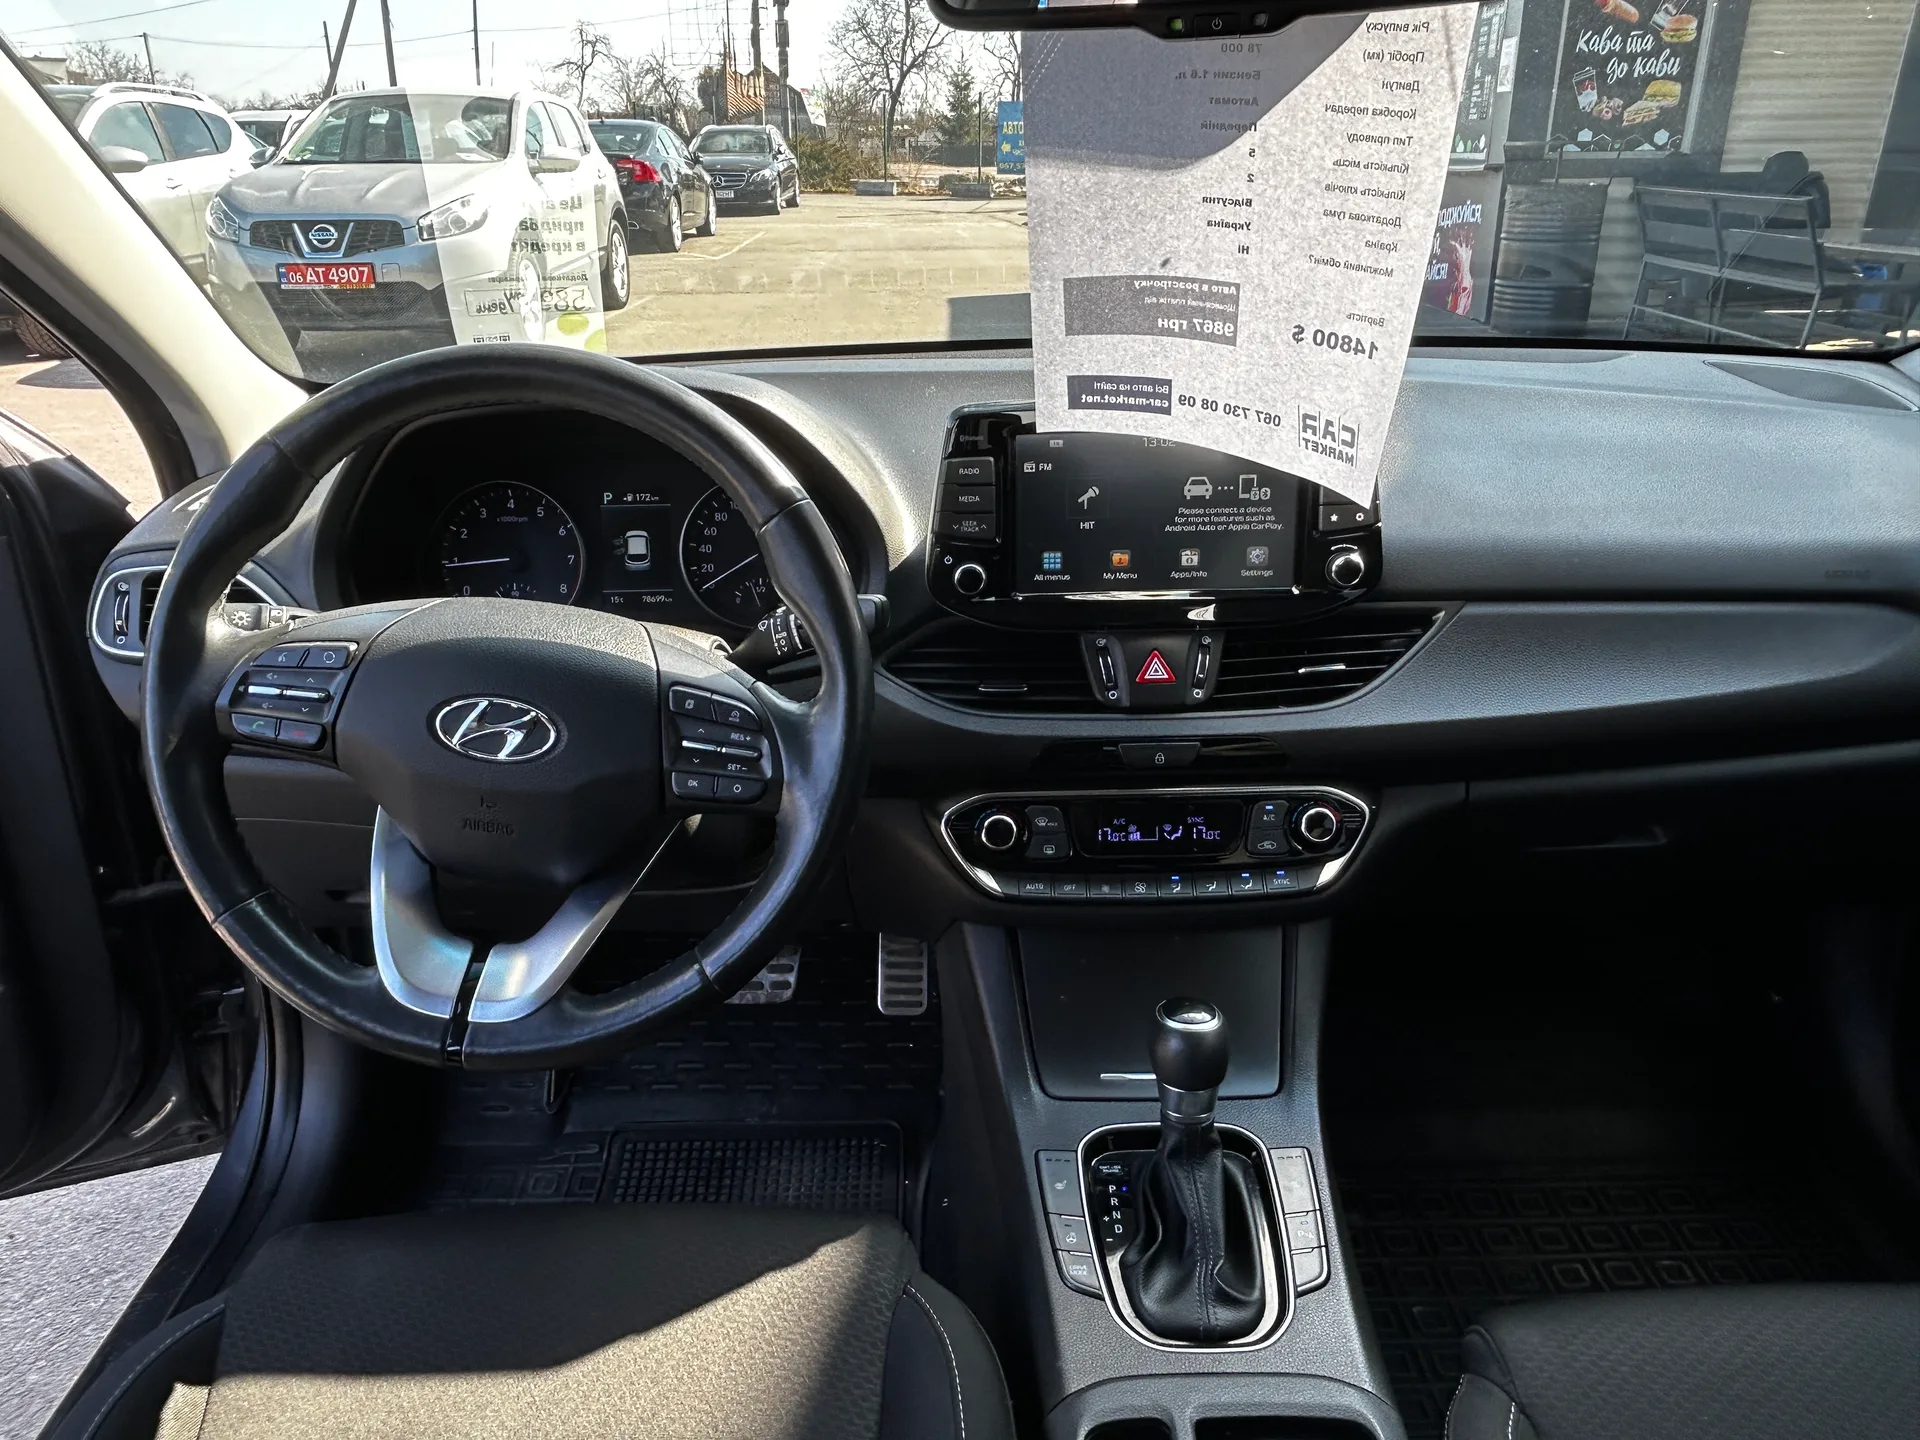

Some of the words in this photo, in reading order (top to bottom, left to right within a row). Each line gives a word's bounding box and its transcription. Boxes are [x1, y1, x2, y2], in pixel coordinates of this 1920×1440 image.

[1576, 25, 1622, 55] Кава
[1626, 30, 1656, 53] та
[1606, 57, 1629, 84] до
[1633, 48, 1680, 77] кави
[289, 272, 304, 284] 06
[306, 267, 326, 284] AT
[328, 266, 369, 284] 4907
[958, 467, 980, 475] RADIO
[1038, 463, 1052, 471] FM
[603, 493, 613, 504] P
[958, 495, 980, 503] MEDIA
[507, 500, 515, 509] 4
[479, 508, 487, 518] 3
[536, 506, 544, 517] 5
[1178, 507, 1204, 515] Please
[1206, 506, 1238, 514] connect
[714, 512, 728, 521] 80
[1080, 521, 1095, 529] HIT
[1165, 524, 1196, 532] Android
[1197, 523, 1216, 531] Auto
[1228, 523, 1250, 532] Apple
[1250, 523, 1284, 531] CarPlay.
[460, 528, 468, 538] 2
[558, 526, 566, 536] 6
[704, 526, 717, 536] 60
[699, 544, 712, 553] 40
[567, 554, 575, 564] 7
[701, 563, 714, 573] 20
[1102, 572, 1115, 581] My
[1170, 570, 1208, 579] Apps/Info
[1240, 569, 1274, 577] Settings
[463, 586, 470, 596] 0
[560, 584, 568, 593] 8
[687, 779, 699, 787] OK
[1187, 816, 1204, 824] SYNC
[1025, 882, 1044, 890] AUTO
[1273, 878, 1290, 886] SYNC
[1108, 1184, 1117, 1194] P
[1110, 1197, 1119, 1206] R
[1112, 1210, 1121, 1219] N
[1114, 1224, 1123, 1234] D
